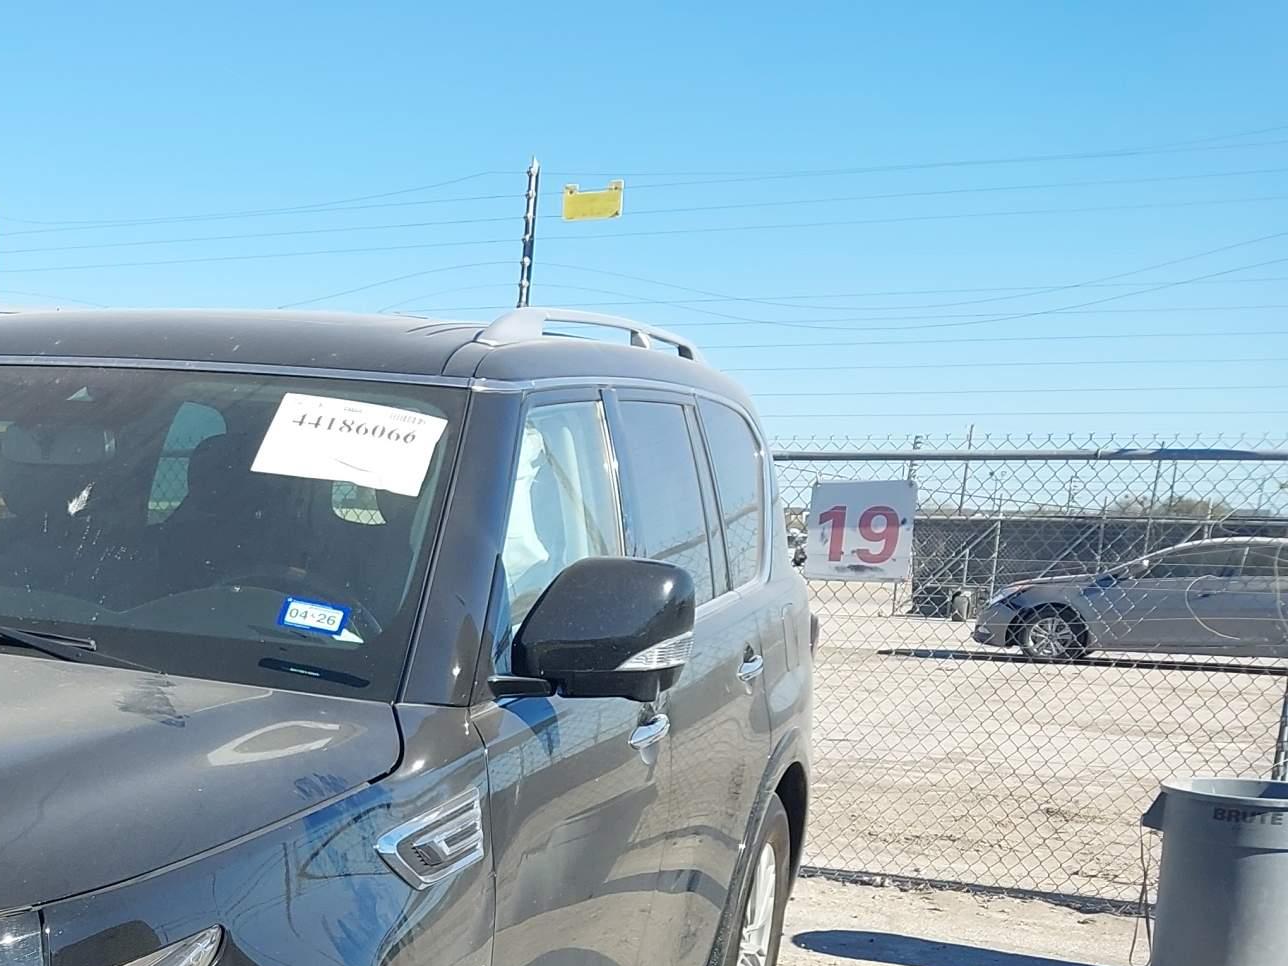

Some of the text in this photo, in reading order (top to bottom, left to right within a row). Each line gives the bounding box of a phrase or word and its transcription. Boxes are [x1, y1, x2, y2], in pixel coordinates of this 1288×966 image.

[292, 413, 416, 444] 44186066
[818, 505, 900, 564] 19
[1213, 807, 1284, 826] BRUTE
